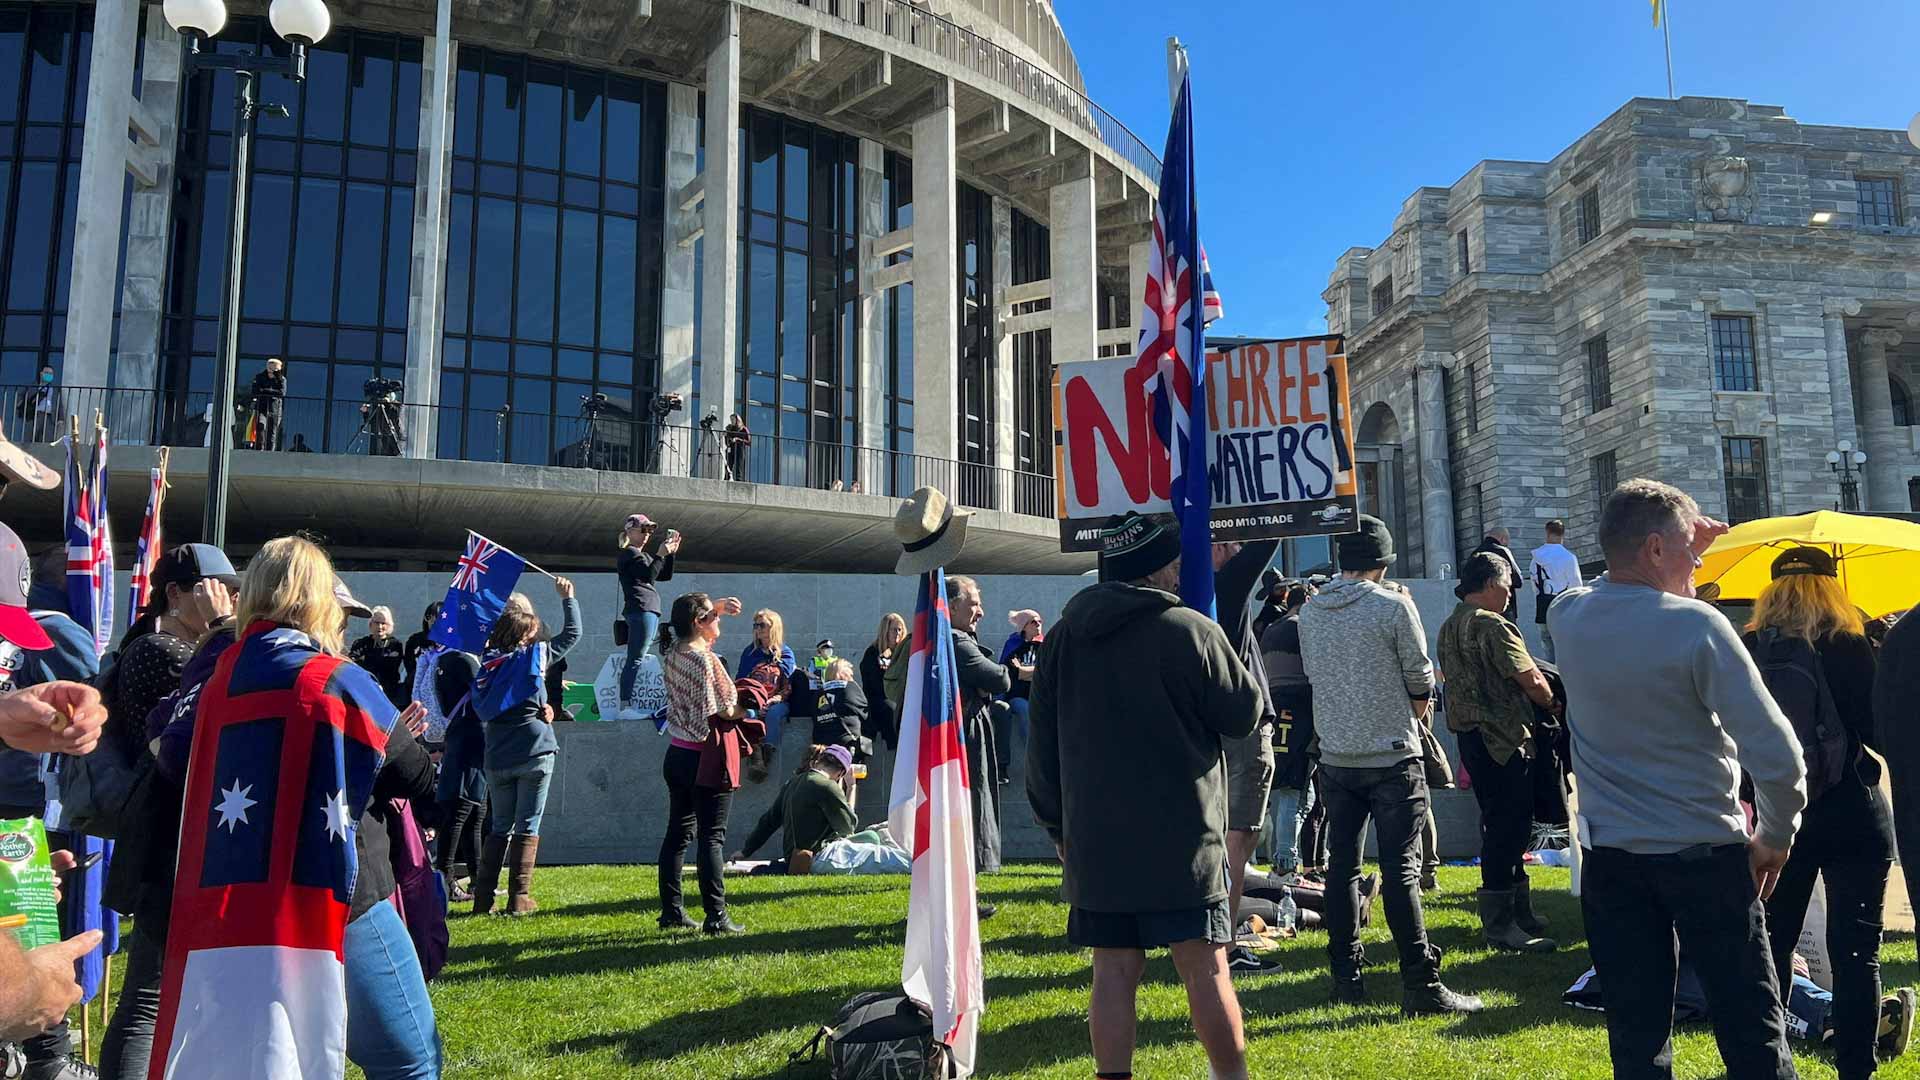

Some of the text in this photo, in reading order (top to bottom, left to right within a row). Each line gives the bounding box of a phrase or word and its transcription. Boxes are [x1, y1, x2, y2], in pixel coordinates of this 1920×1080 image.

[1205, 340, 1328, 432] THREE
[1208, 423, 1333, 505] WATERS
[1209, 514, 1294, 530] 0800 M10 TRADE
[1074, 528, 1103, 541] MIT
[2, 849, 25, 858] Earth
